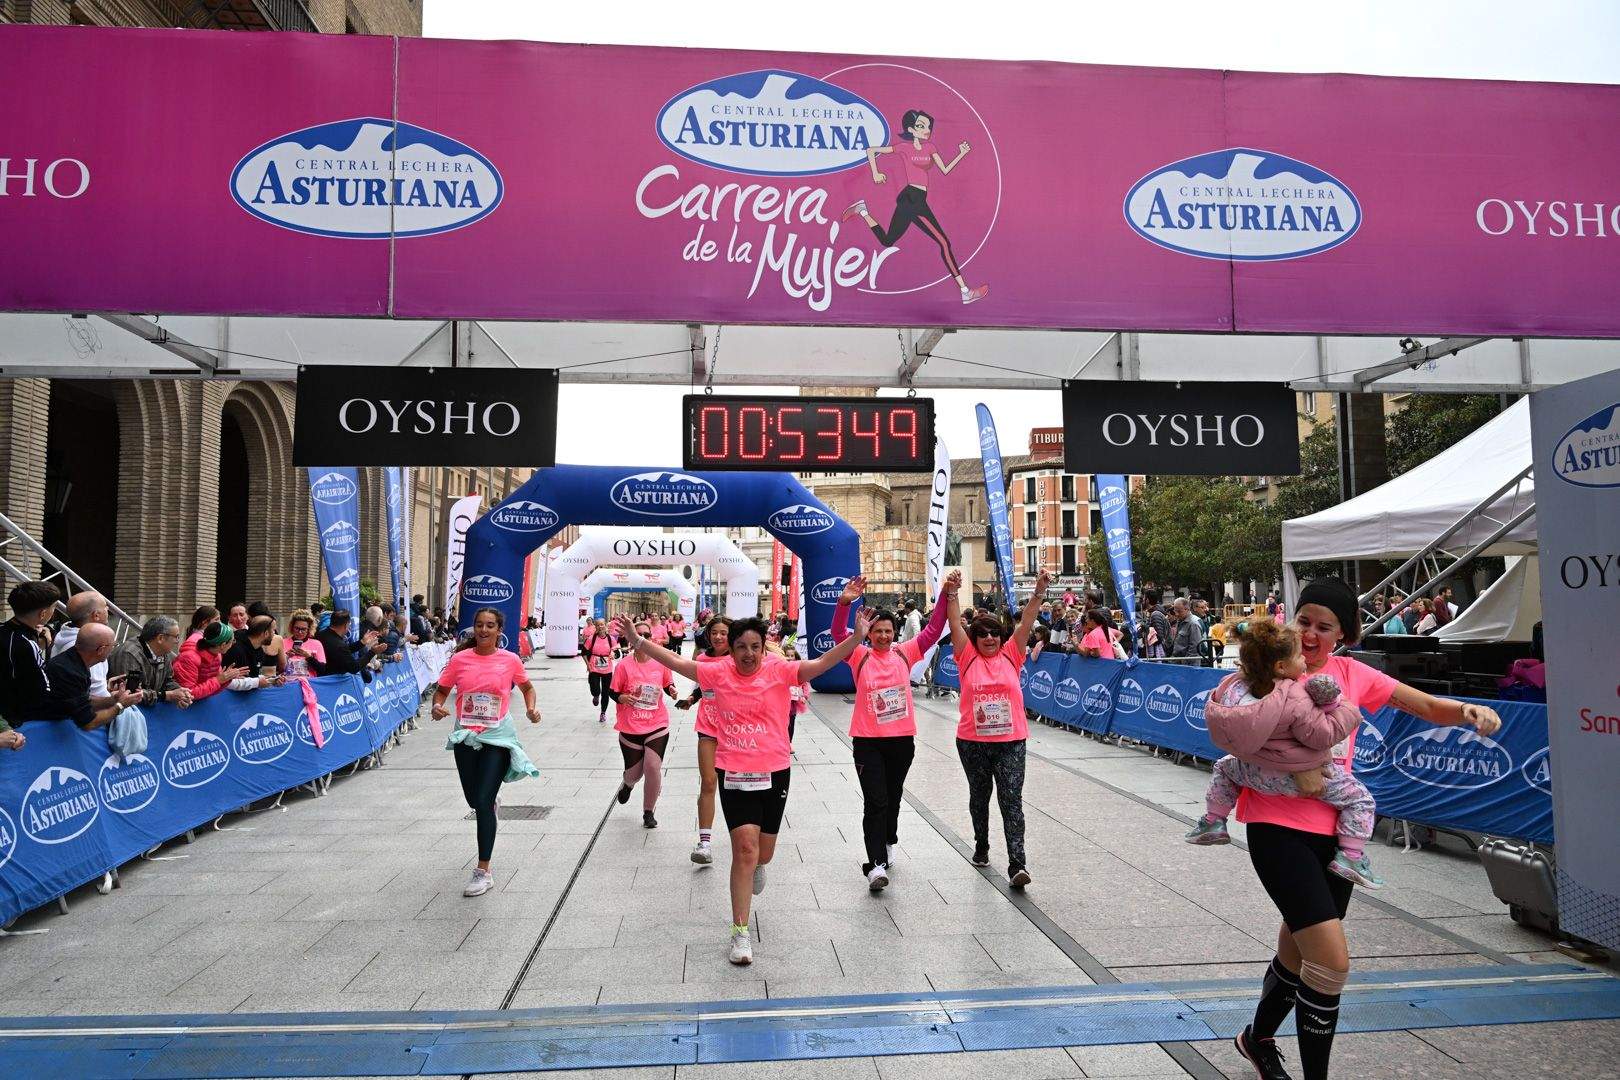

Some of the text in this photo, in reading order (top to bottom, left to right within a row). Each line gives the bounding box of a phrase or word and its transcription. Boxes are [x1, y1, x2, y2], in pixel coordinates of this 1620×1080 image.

[711, 104, 865, 120] CENTRAL LECHERA
[675, 106, 871, 151] ASTURIANA
[295, 158, 474, 173] CENTRAL LECHERA
[251, 160, 483, 208] ASTURIANA
[635, 164, 829, 225] Carrera
[1179, 186, 1336, 199] CENTRAL LECHERA
[1143, 187, 1345, 232] ASTURIANA
[1476, 198, 1620, 237] OYSH
[683, 220, 901, 312] de la Mujer
[338, 398, 521, 437] OYSHO
[1101, 413, 1266, 448] OYSHO
[1562, 443, 1620, 474] ASTU
[618, 484, 710, 505] ASTURIANA
[494, 511, 554, 525] ASTURIANA
[774, 516, 831, 528] ASTURIANA
[613, 539, 696, 557] OYSHO
[1147, 698, 1179, 716] ASTURIANA
[240, 731, 291, 757] ASTURIANA
[725, 723, 768, 735] DORSAL
[725, 737, 757, 748] SUMA
[168, 750, 227, 780] ASTURIANA
[1400, 744, 1501, 778] ASTURIANA
[103, 771, 157, 803] ASTURIANA
[29, 791, 98, 834] ASTURIANA
